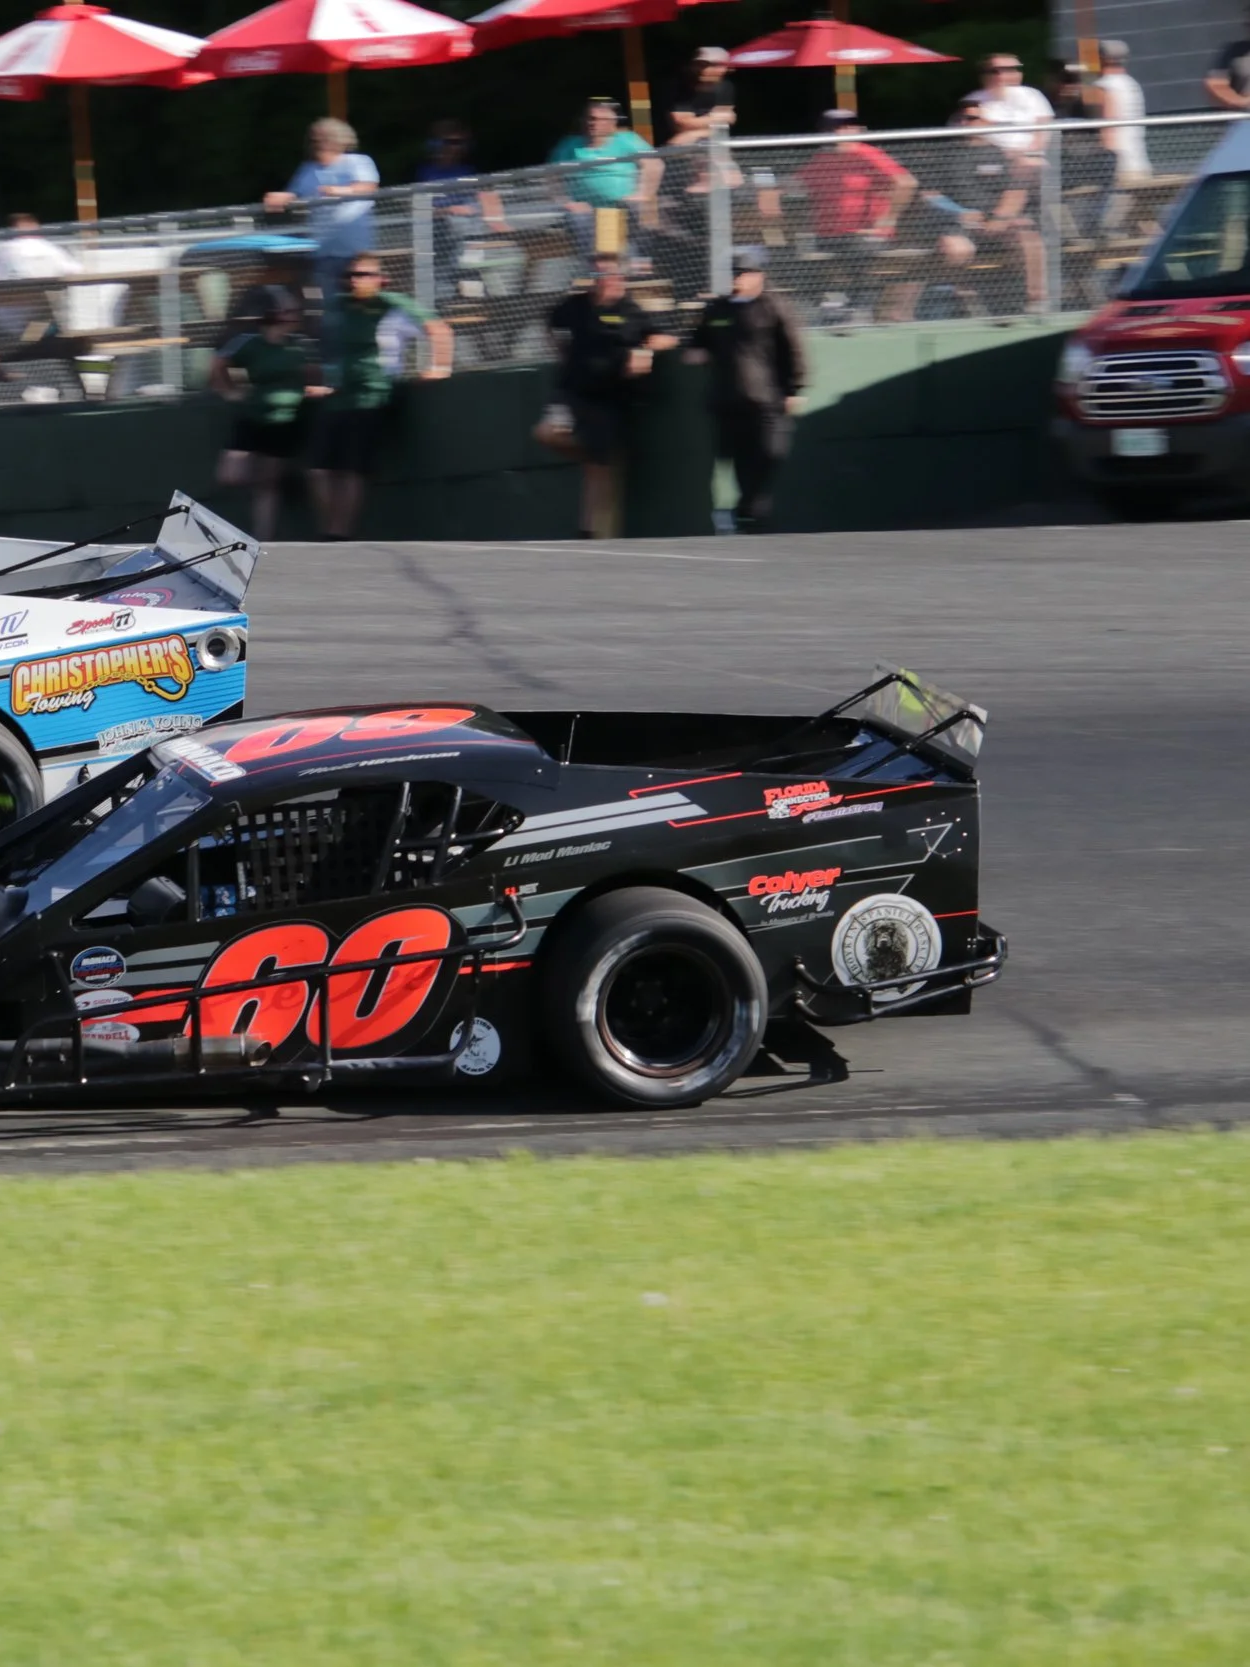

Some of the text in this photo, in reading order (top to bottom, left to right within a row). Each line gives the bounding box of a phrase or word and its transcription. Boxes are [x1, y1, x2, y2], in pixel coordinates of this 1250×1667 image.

[116, 613, 131, 627] 77
[14, 637, 190, 712] CHRISTOPHER'S
[25, 689, 95, 714] Towing
[152, 714, 202, 730] YOUNG
[161, 737, 246, 782] MONACO
[763, 780, 830, 806] FLORIDA
[772, 791, 830, 808] CONNECTION
[520, 849, 555, 864] Mod
[555, 841, 612, 858] Maniac
[748, 867, 841, 896] Colyer
[760, 887, 830, 913] Trucking
[860, 907, 913, 925] SPANIEL
[186, 907, 450, 1049] 60
